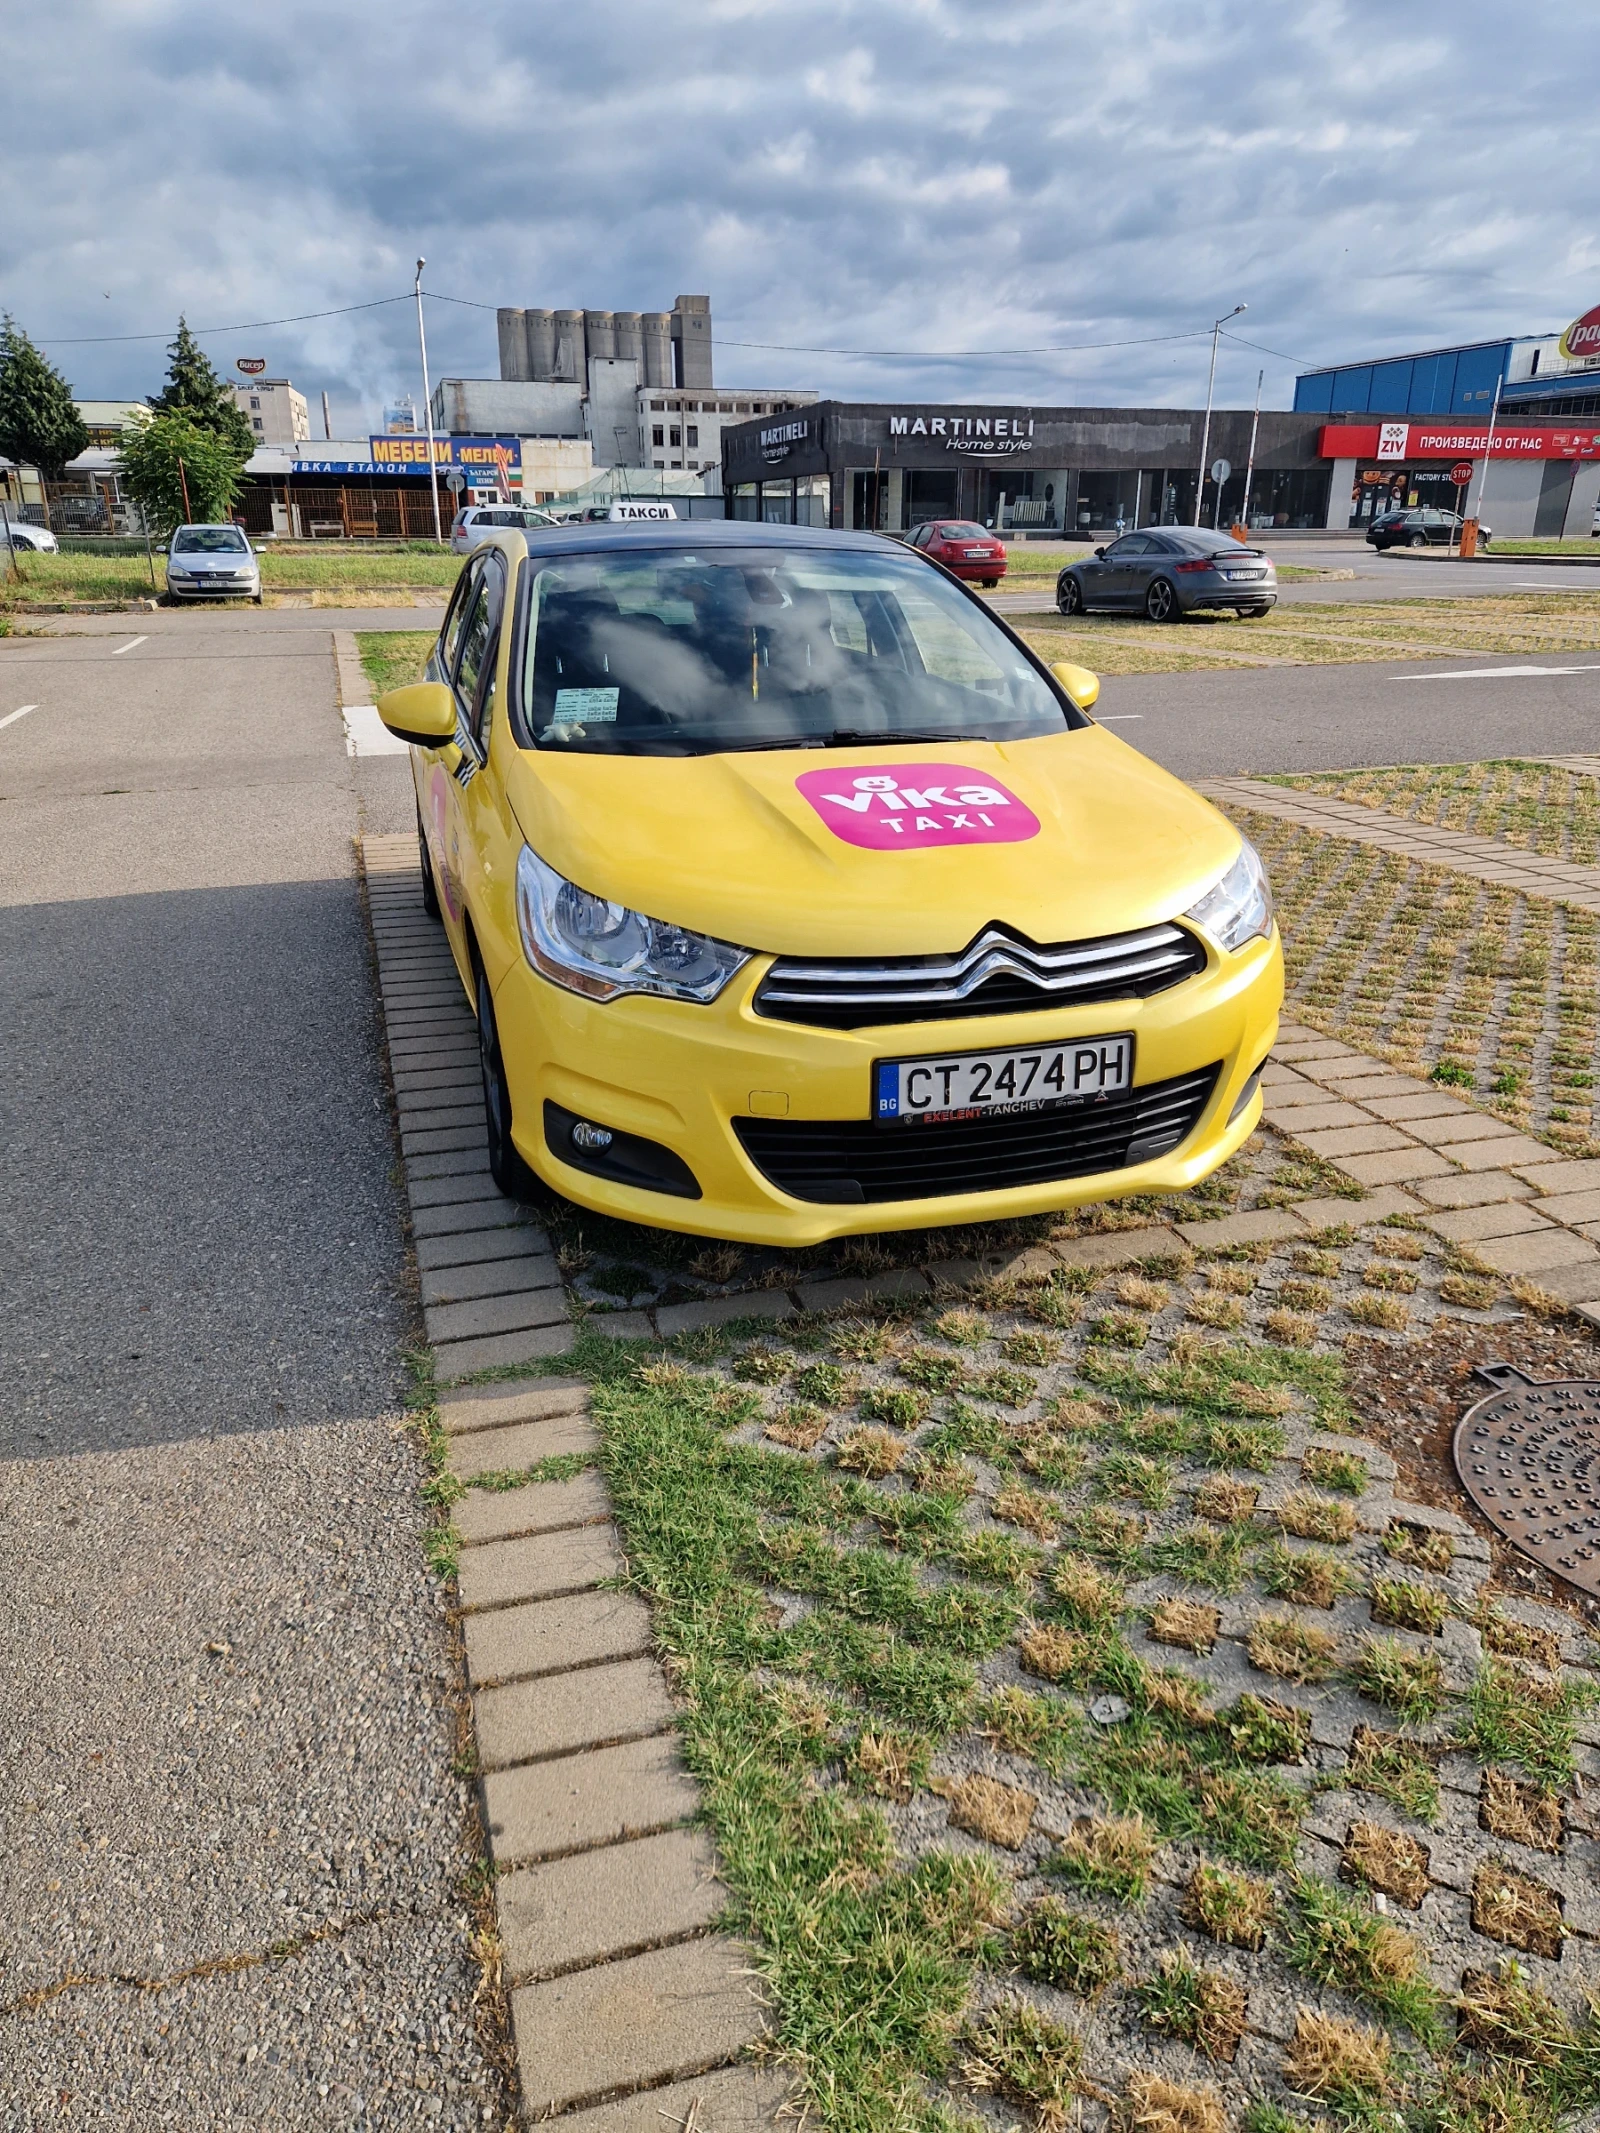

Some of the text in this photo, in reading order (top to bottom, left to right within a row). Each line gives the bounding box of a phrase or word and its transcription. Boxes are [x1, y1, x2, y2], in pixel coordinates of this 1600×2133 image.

[1566, 323, 1600, 351] Гра
[239, 361, 263, 370] Бисер
[761, 420, 808, 446] MARTINELI
[890, 416, 1034, 436] MARTINELI
[946, 438, 1032, 452] Home style
[1380, 440, 1405, 452] ZIV
[1420, 436, 1502, 450] ПРОИЗВЕДЕНО
[1505, 437, 1520, 449] ОТ
[1520, 437, 1543, 450] НАС
[372, 441, 453, 462] МЕБЕЛИ
[762, 448, 777, 459] Home
[348, 463, 407, 473] ЕТАЛОН
[1453, 469, 1471, 478] STOP
[1415, 473, 1440, 481] FACTORY
[618, 507, 669, 519] ТАКСИ
[880, 813, 996, 834] TAXI
[969, 1053, 1066, 1103] 2474
[879, 1098, 897, 1112] BG
